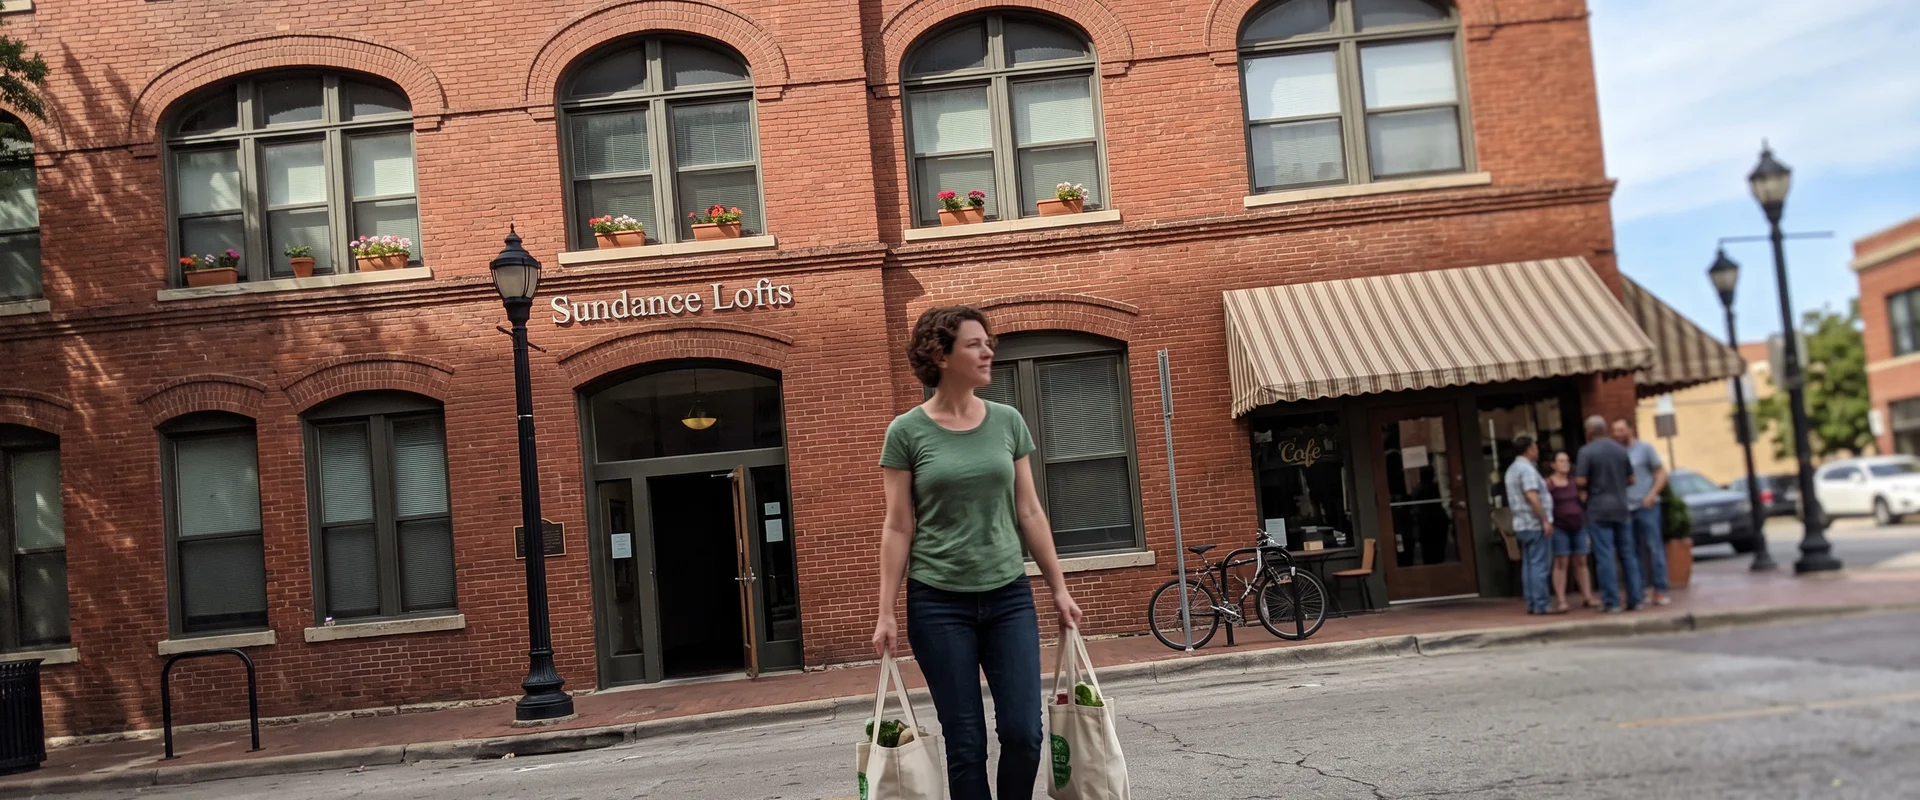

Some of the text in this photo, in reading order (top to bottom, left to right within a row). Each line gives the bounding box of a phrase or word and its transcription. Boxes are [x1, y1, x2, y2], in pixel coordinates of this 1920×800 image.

[551, 278, 793, 325] Sundance Lofts
[1278, 438, 1321, 468] Cafe
